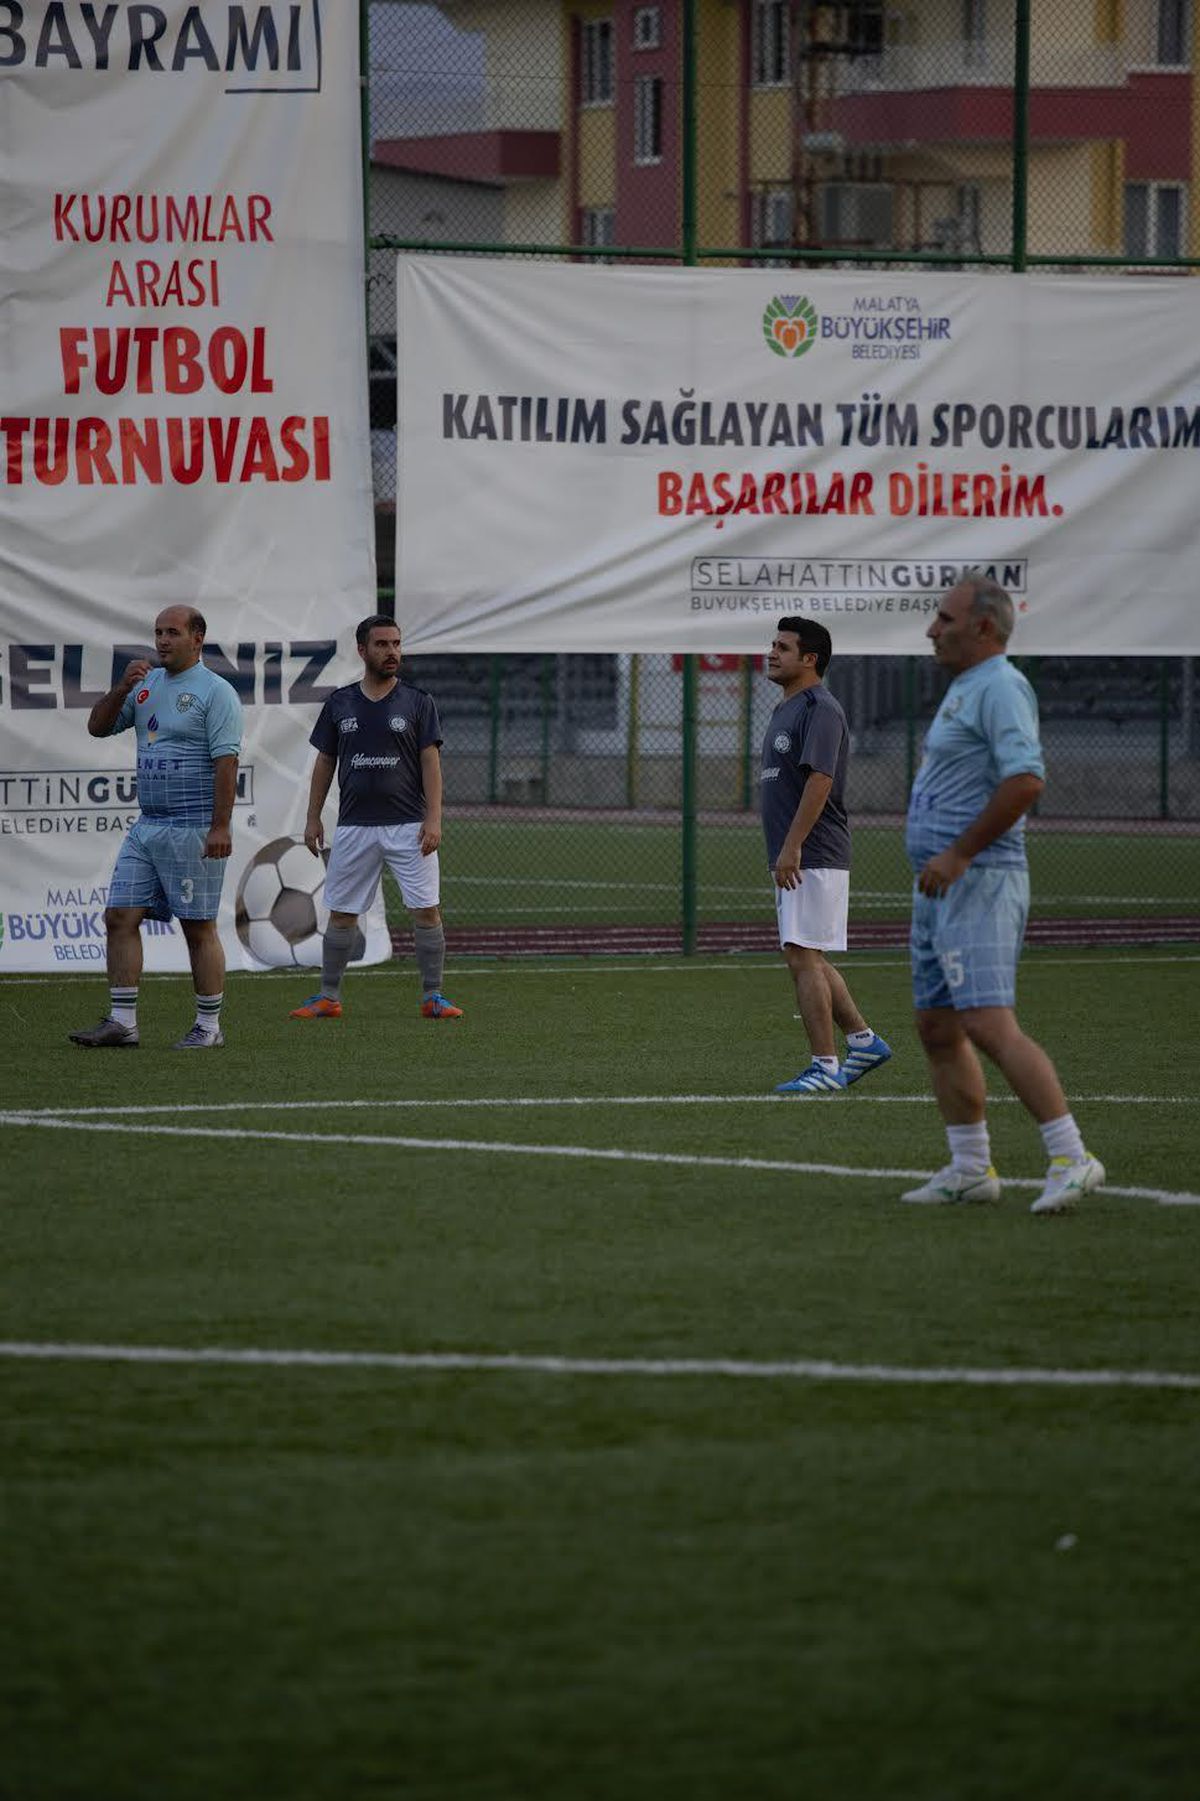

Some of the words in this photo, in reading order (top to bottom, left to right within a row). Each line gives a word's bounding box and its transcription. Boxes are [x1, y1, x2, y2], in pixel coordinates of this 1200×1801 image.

[0, 0, 301, 71] BAYRAMI
[53, 193, 275, 243] KURUMLAR
[106, 259, 220, 307] ARASI
[853, 297, 920, 312] MALATYA
[59, 326, 274, 396] FUTBOL
[442, 393, 607, 444] KATILIM
[620, 387, 825, 447] SAĞLAYAN
[836, 392, 919, 447] TÜM
[0, 416, 331, 486] TURNUVASI
[657, 471, 876, 529] BAŞARILAR
[889, 462, 1065, 517] DİLERİM.
[811, 597, 894, 612] BELEDİYE
[180, 878, 194, 904] 3
